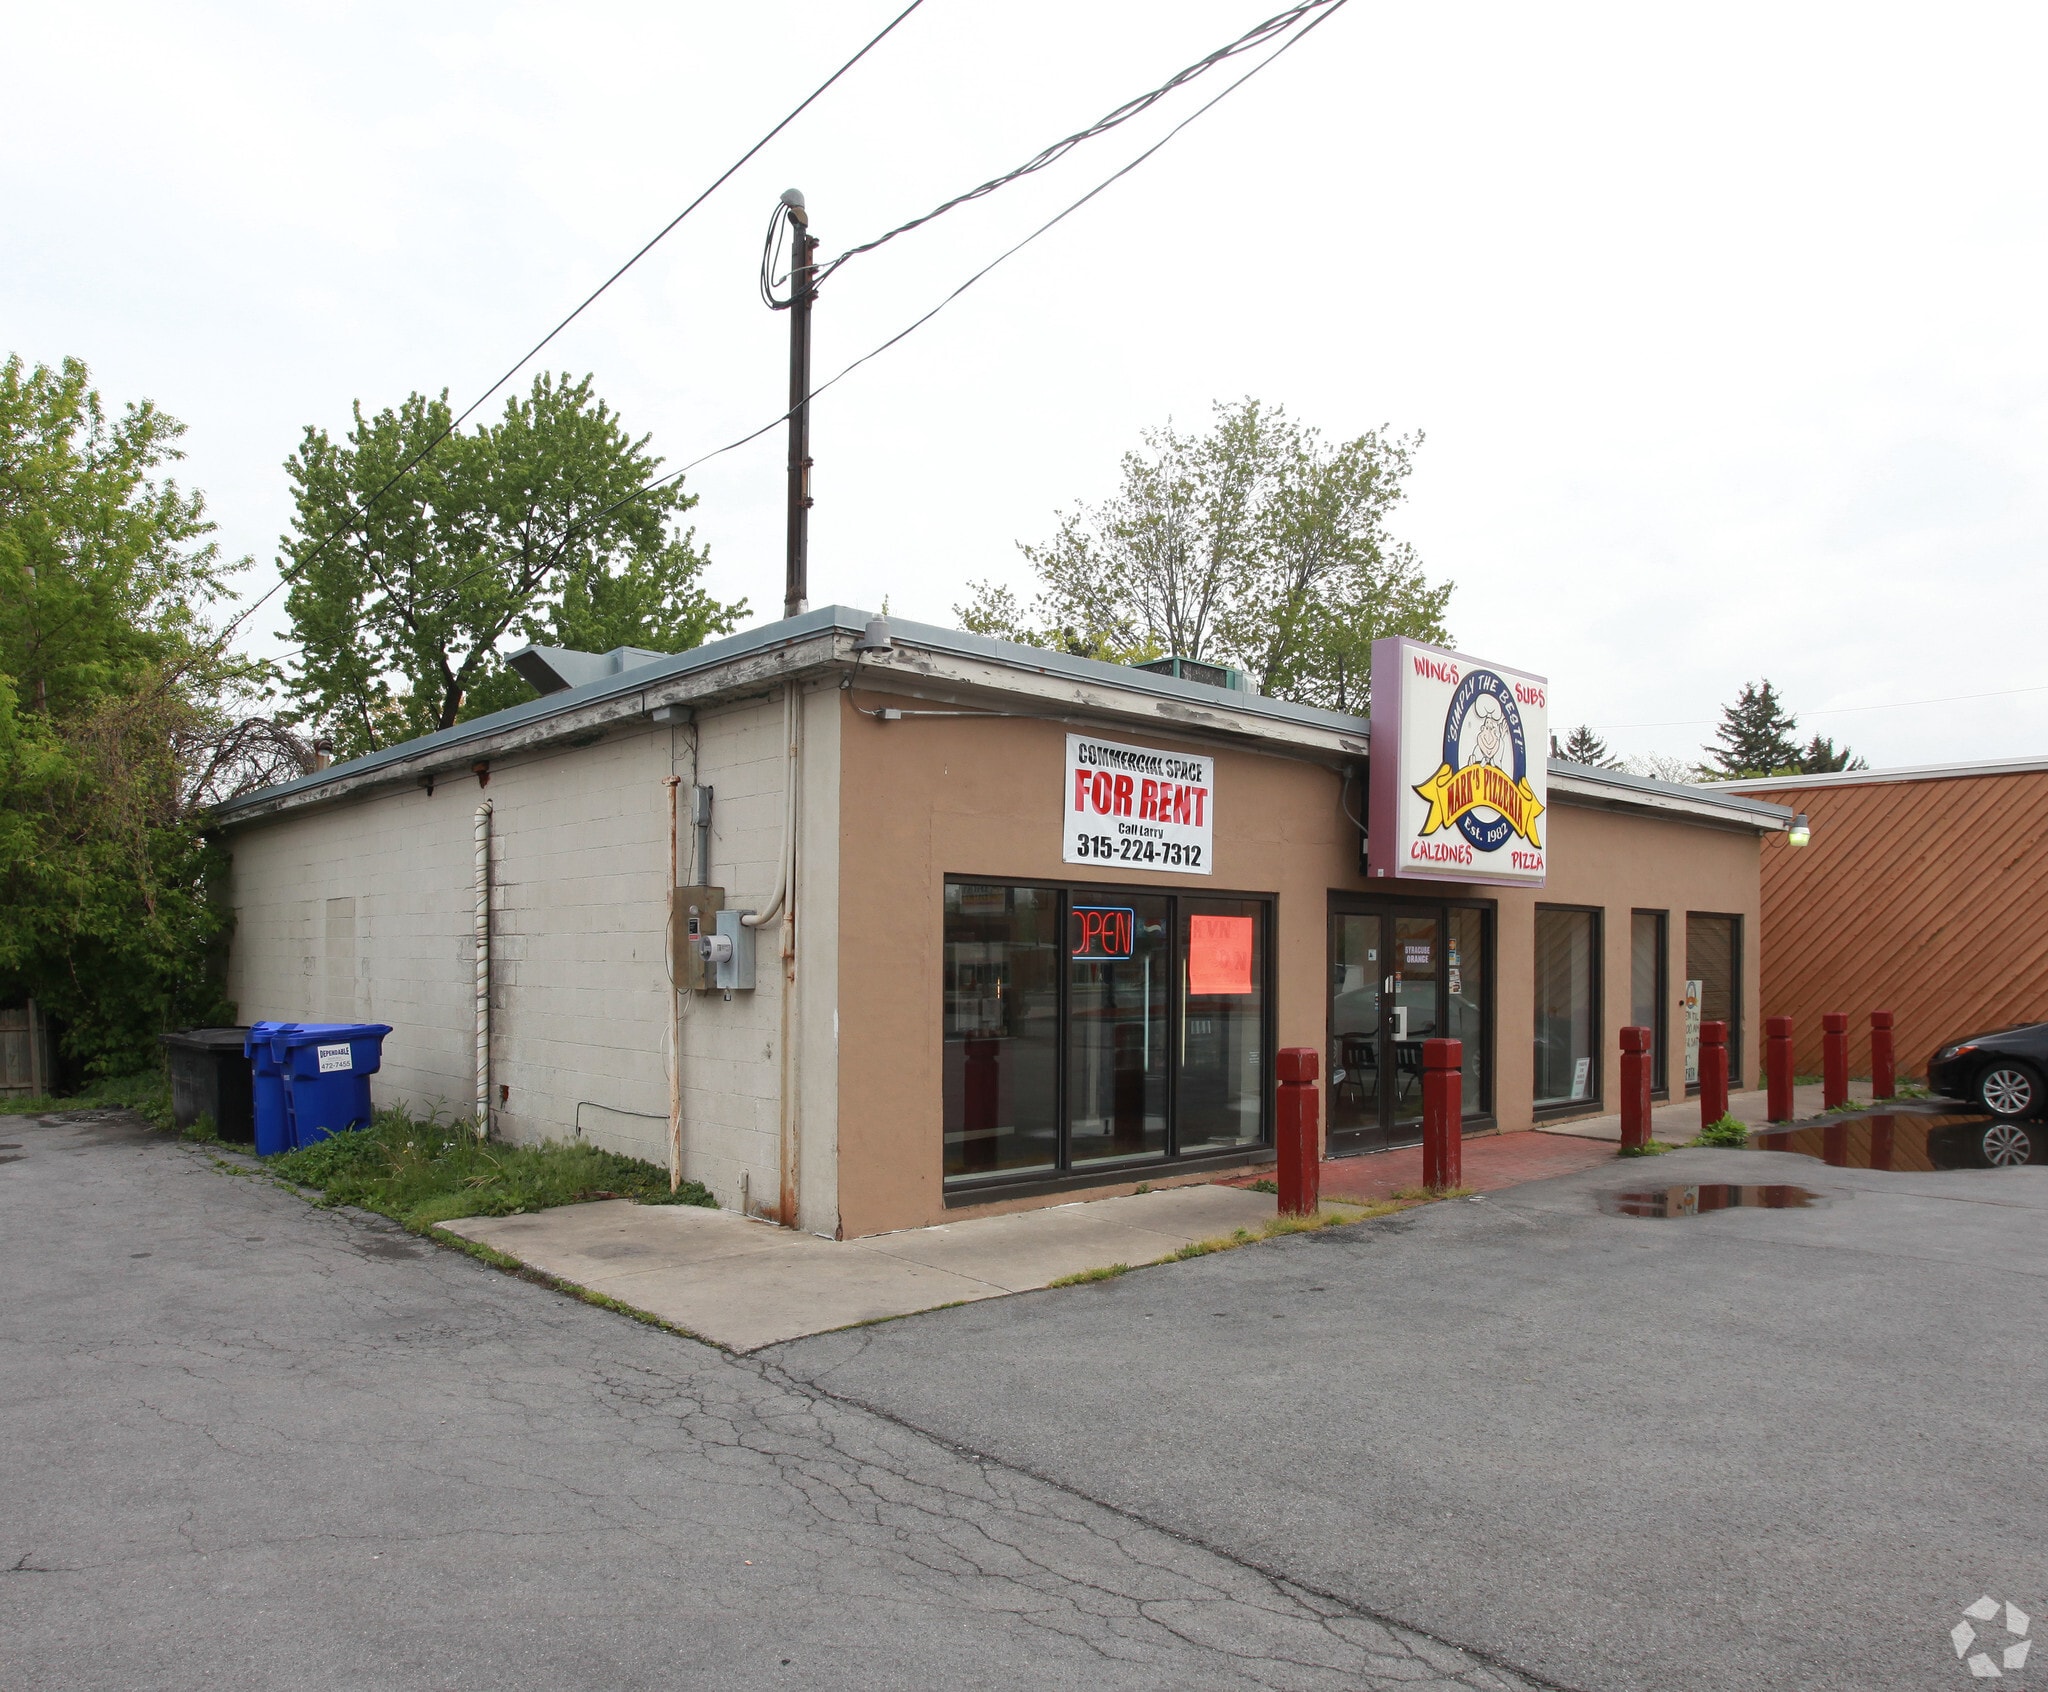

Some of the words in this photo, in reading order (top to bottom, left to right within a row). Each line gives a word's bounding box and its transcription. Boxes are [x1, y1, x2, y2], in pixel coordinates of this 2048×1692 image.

[1413, 655, 1460, 685] WINGS
[1478, 674, 1499, 693] THE
[1514, 682, 1546, 709] SUBS
[1078, 742, 1164, 776] COMMERCIAL
[1166, 758, 1203, 783] SPACE
[1074, 768, 1134, 818] FOR
[1138, 778, 1209, 827] RENT
[1447, 767, 1480, 822] MARK'S
[1483, 768, 1523, 832] PIZZERIA
[1118, 822, 1137, 836] Call
[1139, 825, 1164, 840] Larry
[1464, 816, 1483, 841] Est.
[1487, 822, 1509, 843] 1982
[1077, 833, 1202, 867] 315-224-7312
[1410, 840, 1474, 865] CALZONES
[1511, 850, 1545, 871] PIZZA
[1404, 946, 1430, 955] SYRACUSE
[1406, 955, 1429, 964] ORANGE
[320, 1047, 349, 1058] DEPENDABLE
[321, 1061, 350, 1069] 472-7455
